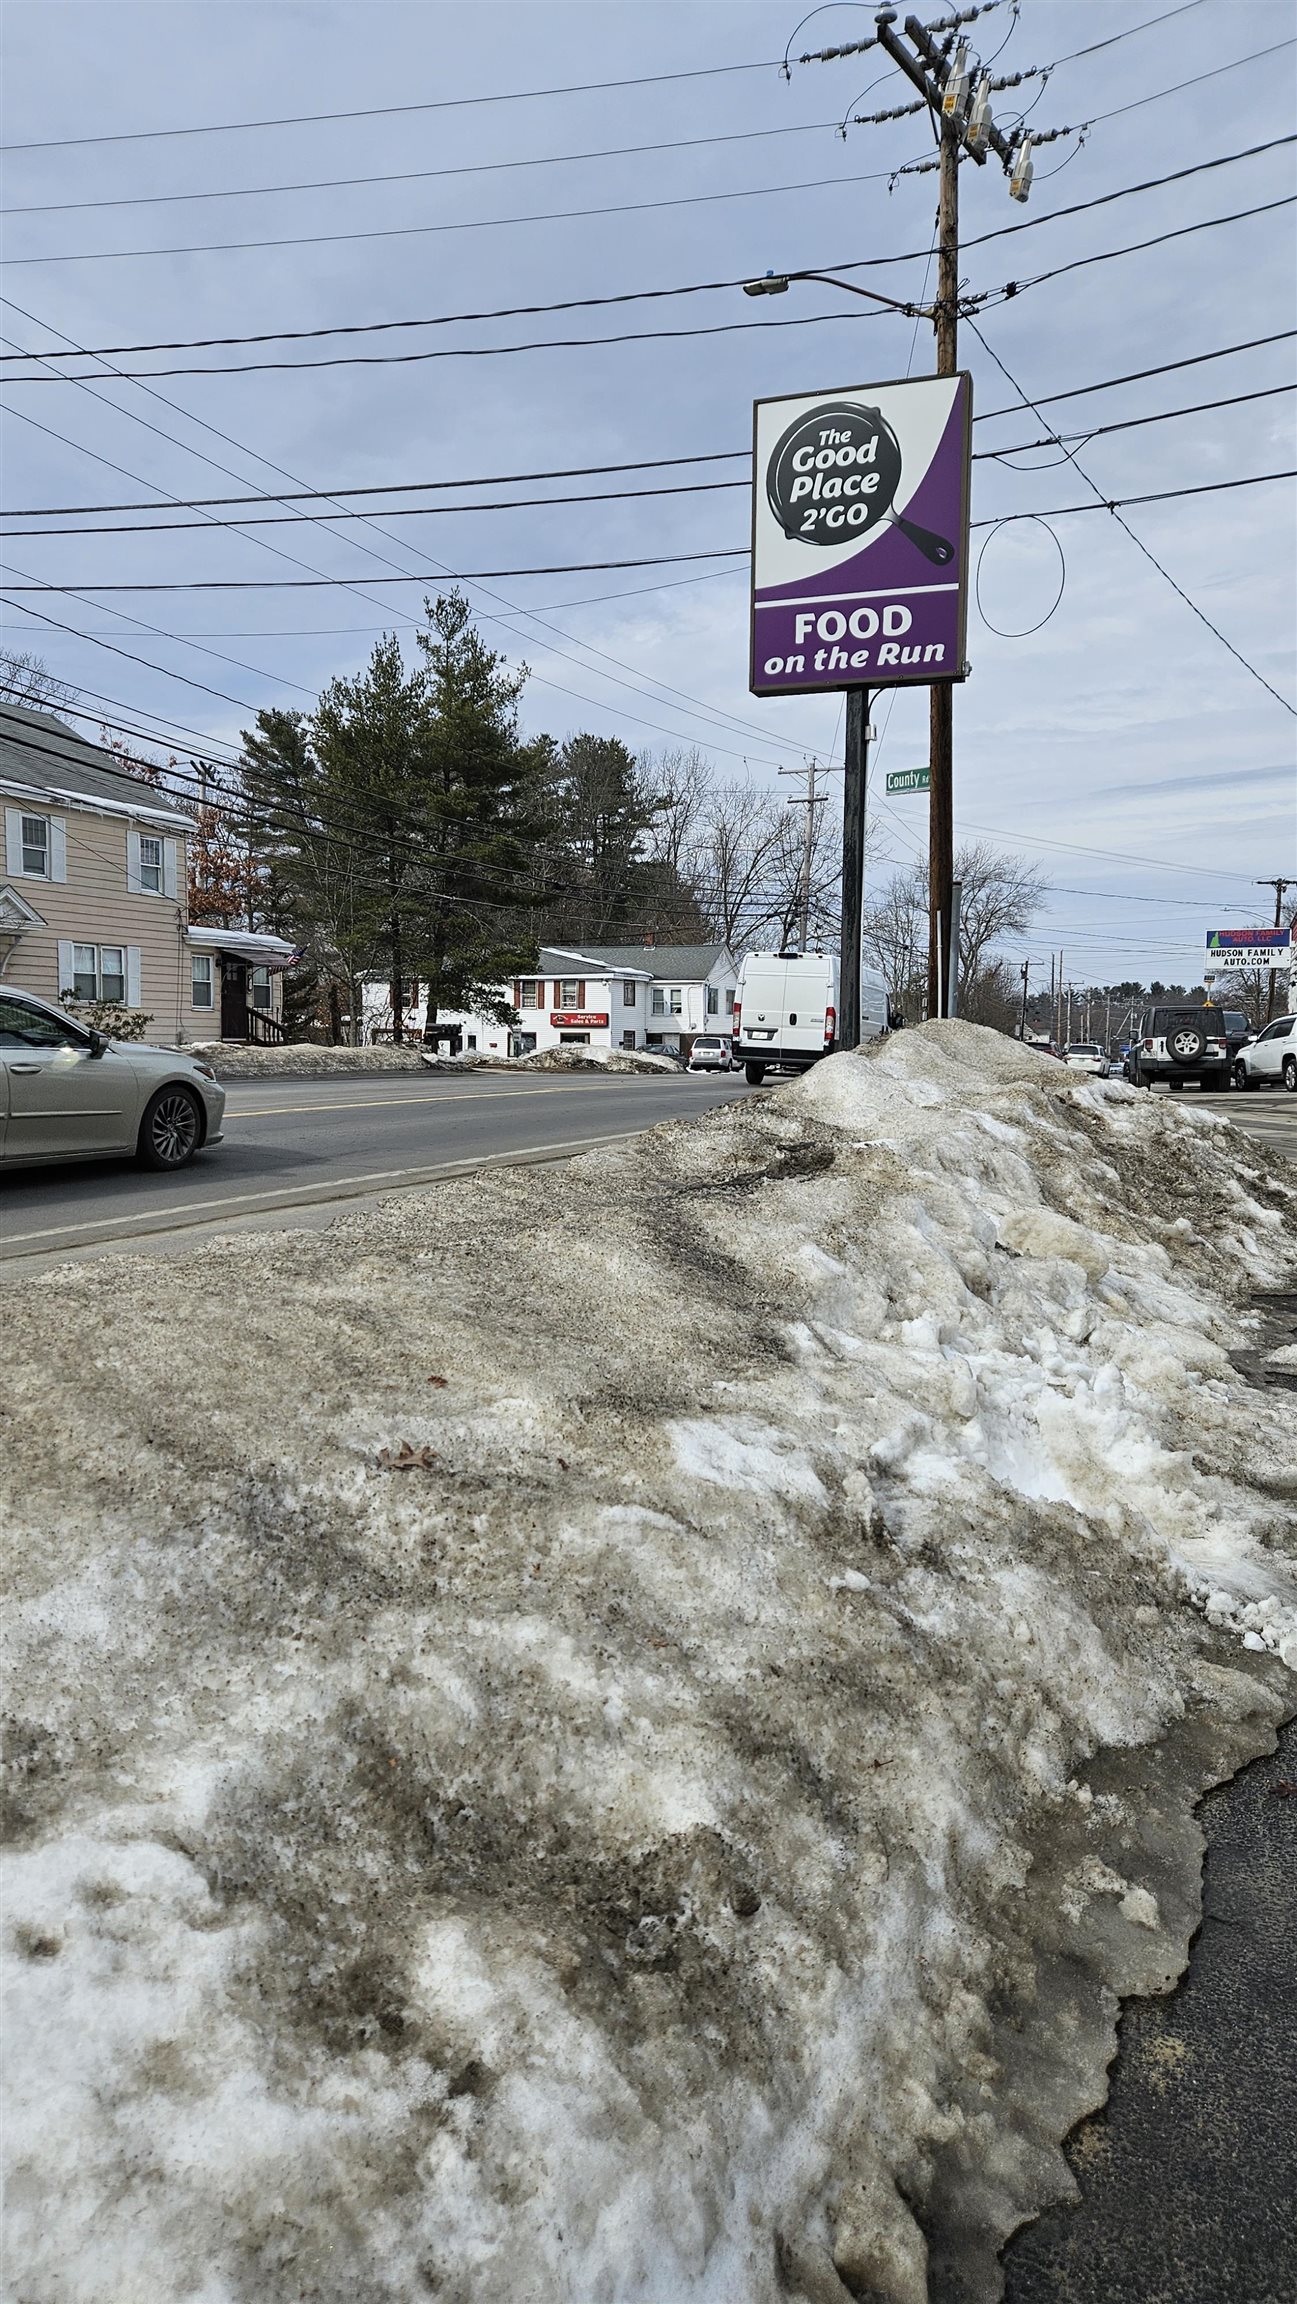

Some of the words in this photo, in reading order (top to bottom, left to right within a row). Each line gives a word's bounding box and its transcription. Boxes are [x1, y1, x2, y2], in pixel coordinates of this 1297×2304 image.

[818, 428, 852, 445] The
[791, 435, 879, 472] Good
[789, 472, 880, 503] Place
[799, 503, 869, 531] 2'GO
[794, 604, 913, 645] FOOD
[764, 652, 805, 675] on
[814, 643, 870, 671] the
[876, 641, 945, 666] Run
[888, 771, 920, 789] County
[1223, 957, 1270, 966] AUTO.COM
[1248, 948, 1284, 957] FAMILY
